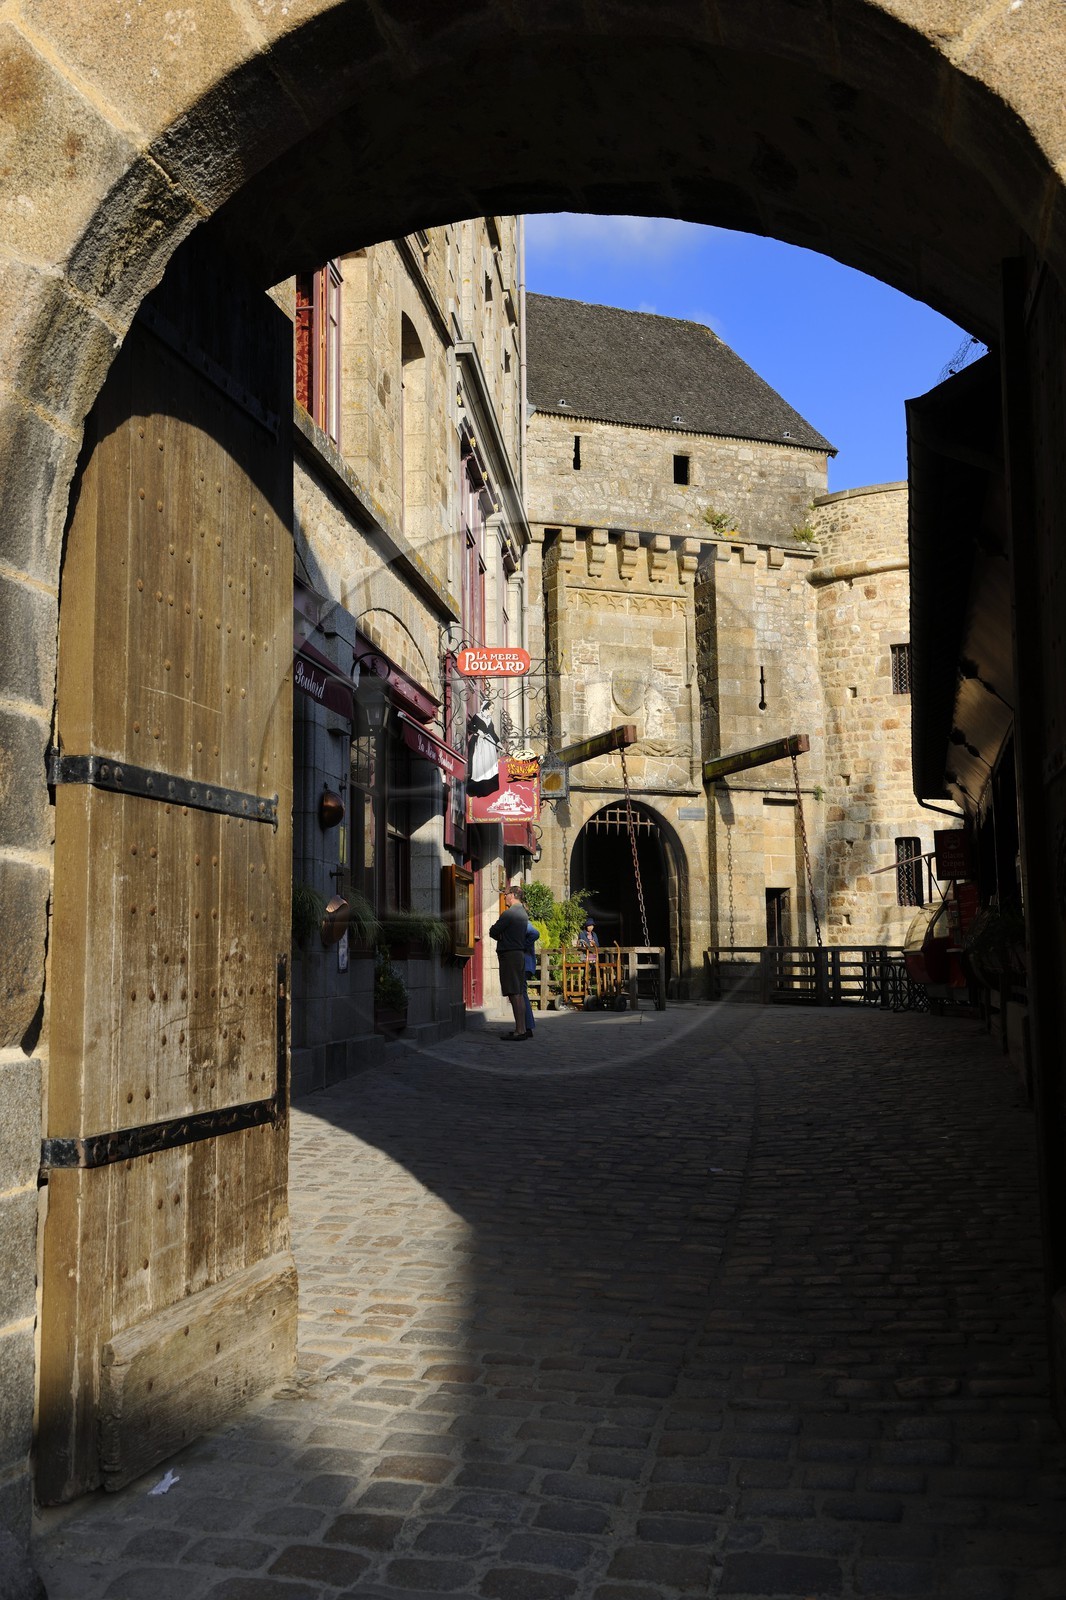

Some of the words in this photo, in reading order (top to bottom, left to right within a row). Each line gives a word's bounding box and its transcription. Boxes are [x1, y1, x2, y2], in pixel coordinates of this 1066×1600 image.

[464, 652, 525, 673] POULARD
[476, 651, 488, 660] LA
[294, 660, 327, 700] Poulard
[942, 850, 965, 859] Glaces
